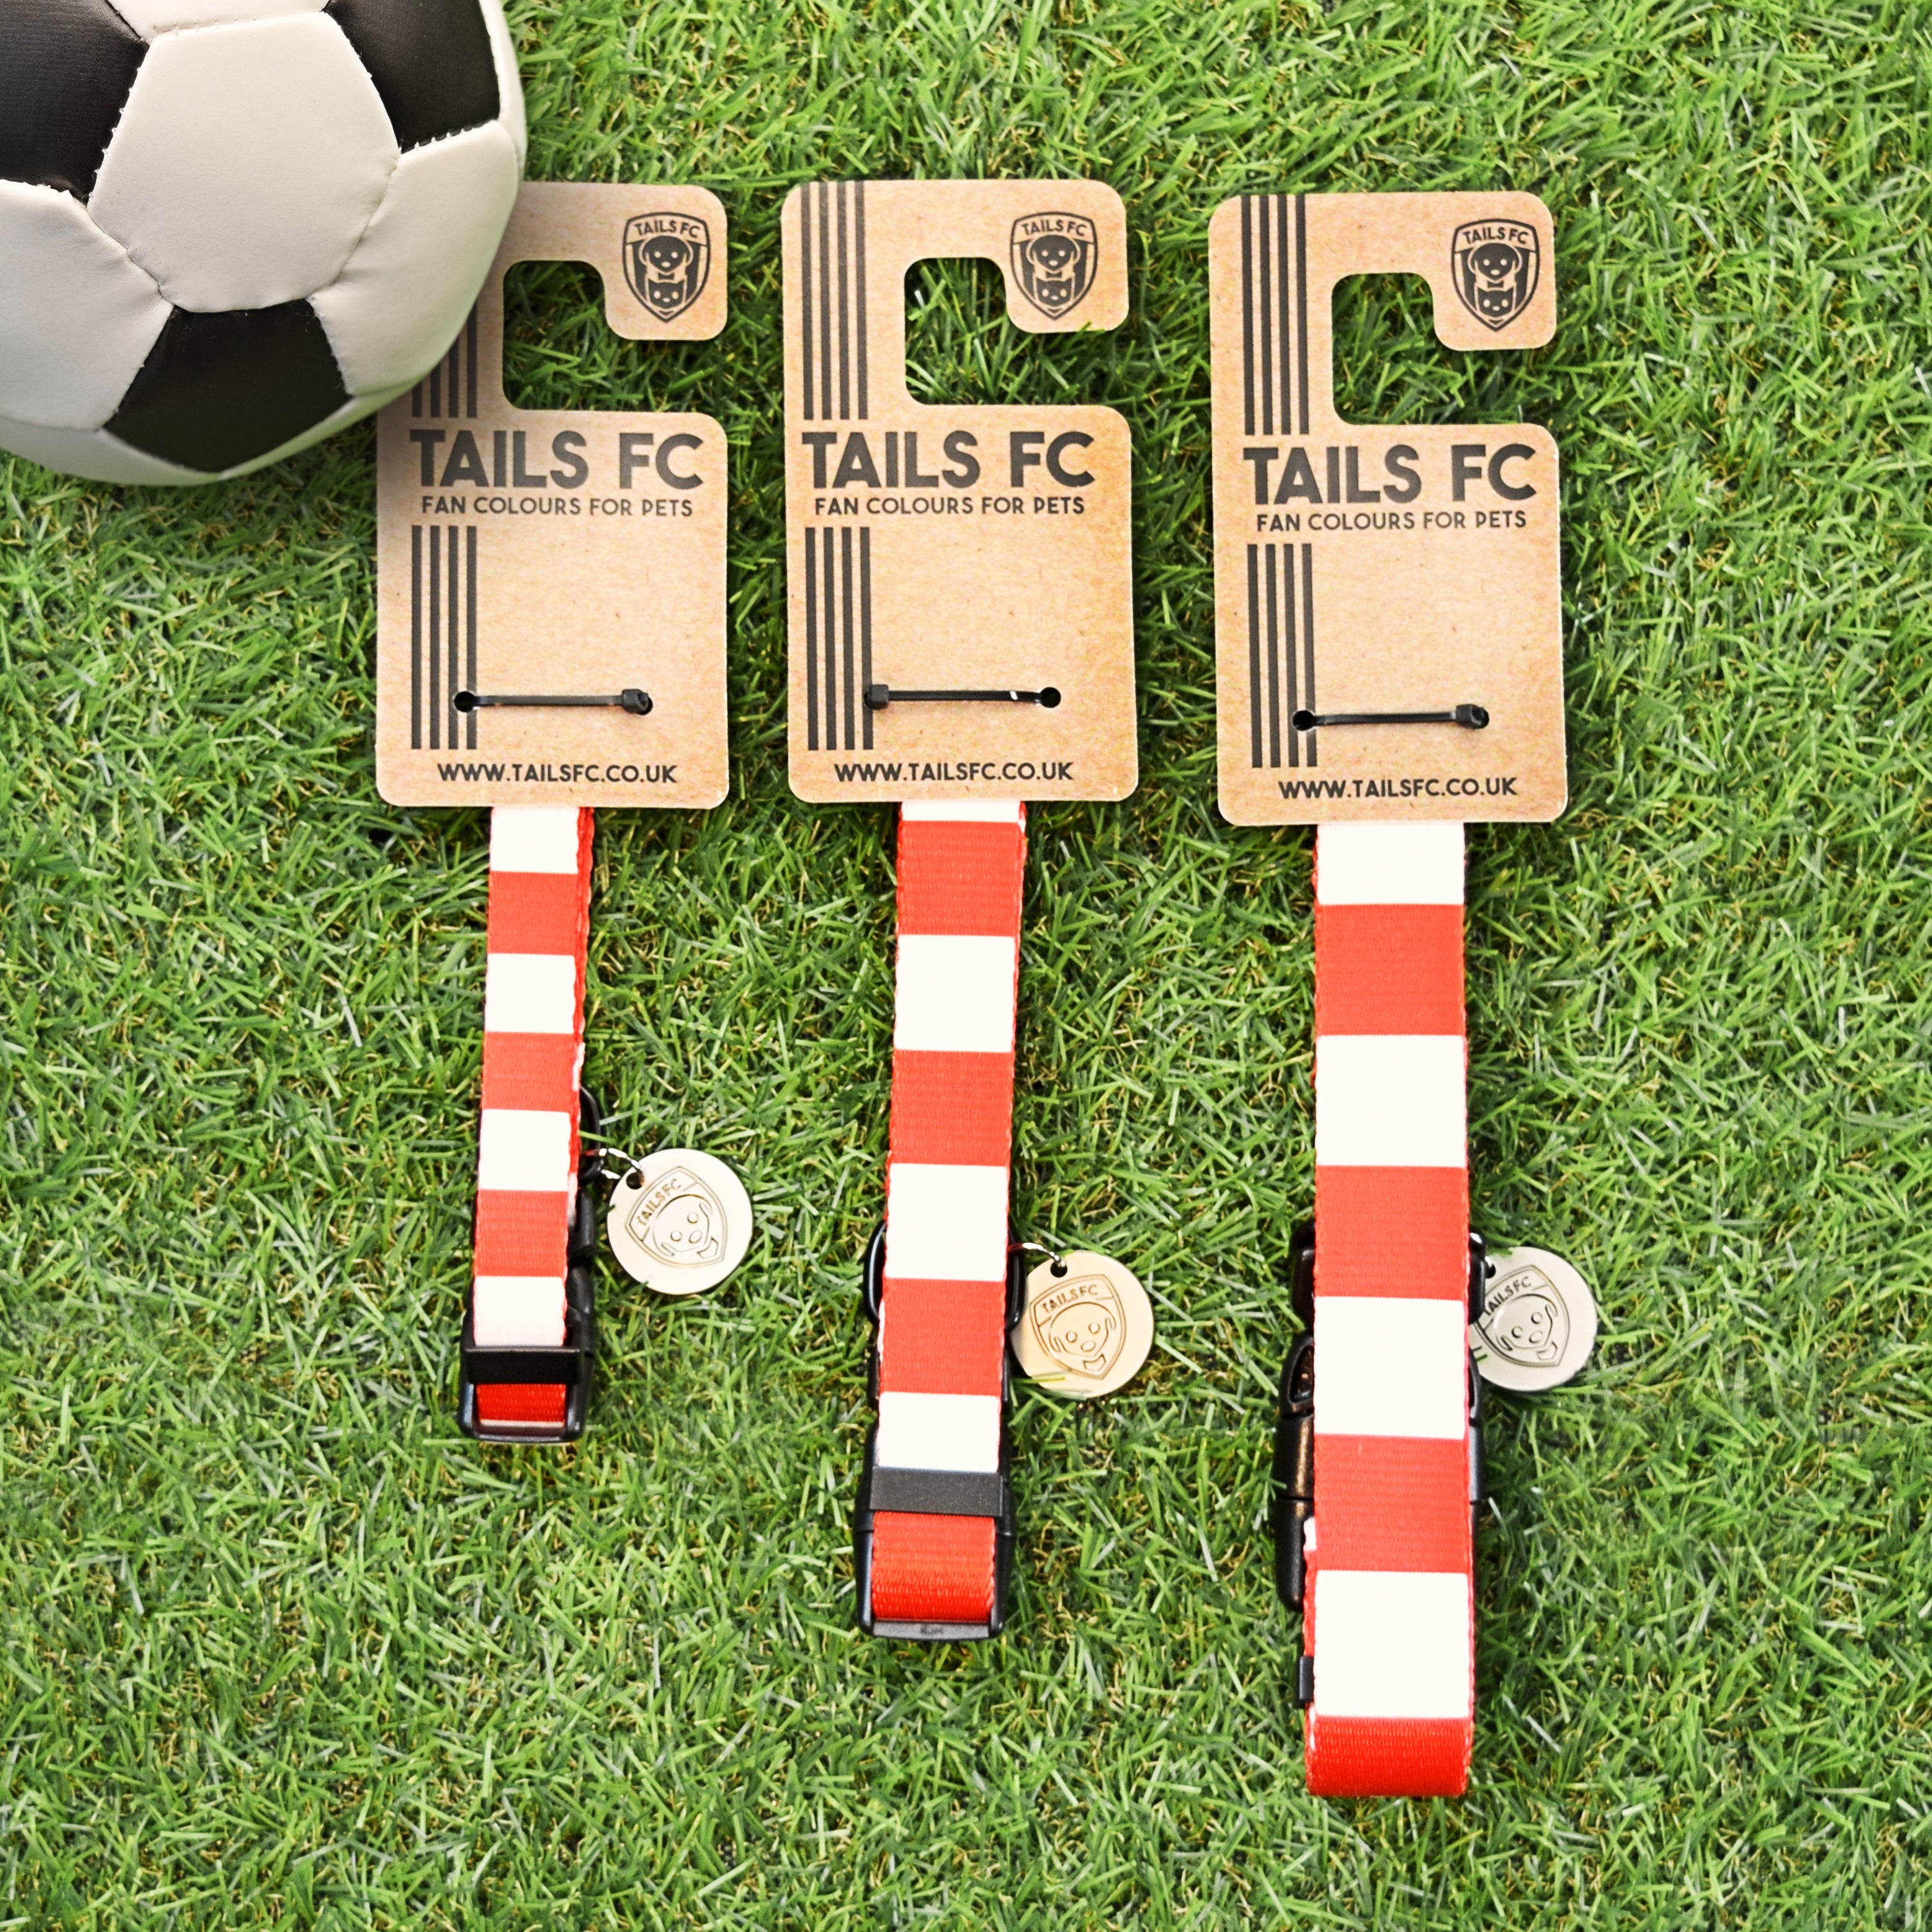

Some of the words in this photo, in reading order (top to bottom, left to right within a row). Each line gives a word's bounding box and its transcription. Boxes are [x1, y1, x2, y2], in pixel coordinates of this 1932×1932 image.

[635, 220, 676, 235] TAILS
[680, 222, 700, 238] FC
[1021, 220, 1063, 235] TAILS
[1066, 221, 1087, 236] FC
[1463, 227, 1505, 244] TAILS
[1509, 229, 1528, 244] FC
[410, 430, 589, 489] TAILS
[619, 432, 704, 489] FC
[801, 430, 980, 489] TAILS
[1010, 431, 1095, 488] FC
[1243, 444, 1422, 505] TAILS
[1451, 444, 1537, 502] FC
[422, 496, 466, 514] FAN
[474, 497, 580, 515] COLOURS
[590, 498, 632, 516] FOR
[642, 498, 692, 516] PETS
[815, 497, 858, 515] FAN
[866, 497, 973, 515] COLOURS
[981, 497, 1025, 515] FOR
[1034, 497, 1084, 514] PETS
[1257, 514, 1300, 532] FAN
[1308, 512, 1415, 531] COLOURS
[1423, 511, 1466, 529] FOR
[1475, 510, 1526, 528] PETS
[437, 764, 677, 783] WWW.TAILSFC.CO.UK
[834, 762, 1074, 782] WWW.TAILSFC.CO.UK
[1278, 777, 1517, 799] WWW.TAILSFC.CO.UK
[1513, 1276, 1532, 1293] FC
[1041, 1291, 1079, 1314] TAILS
[1078, 1284, 1098, 1299] FC
